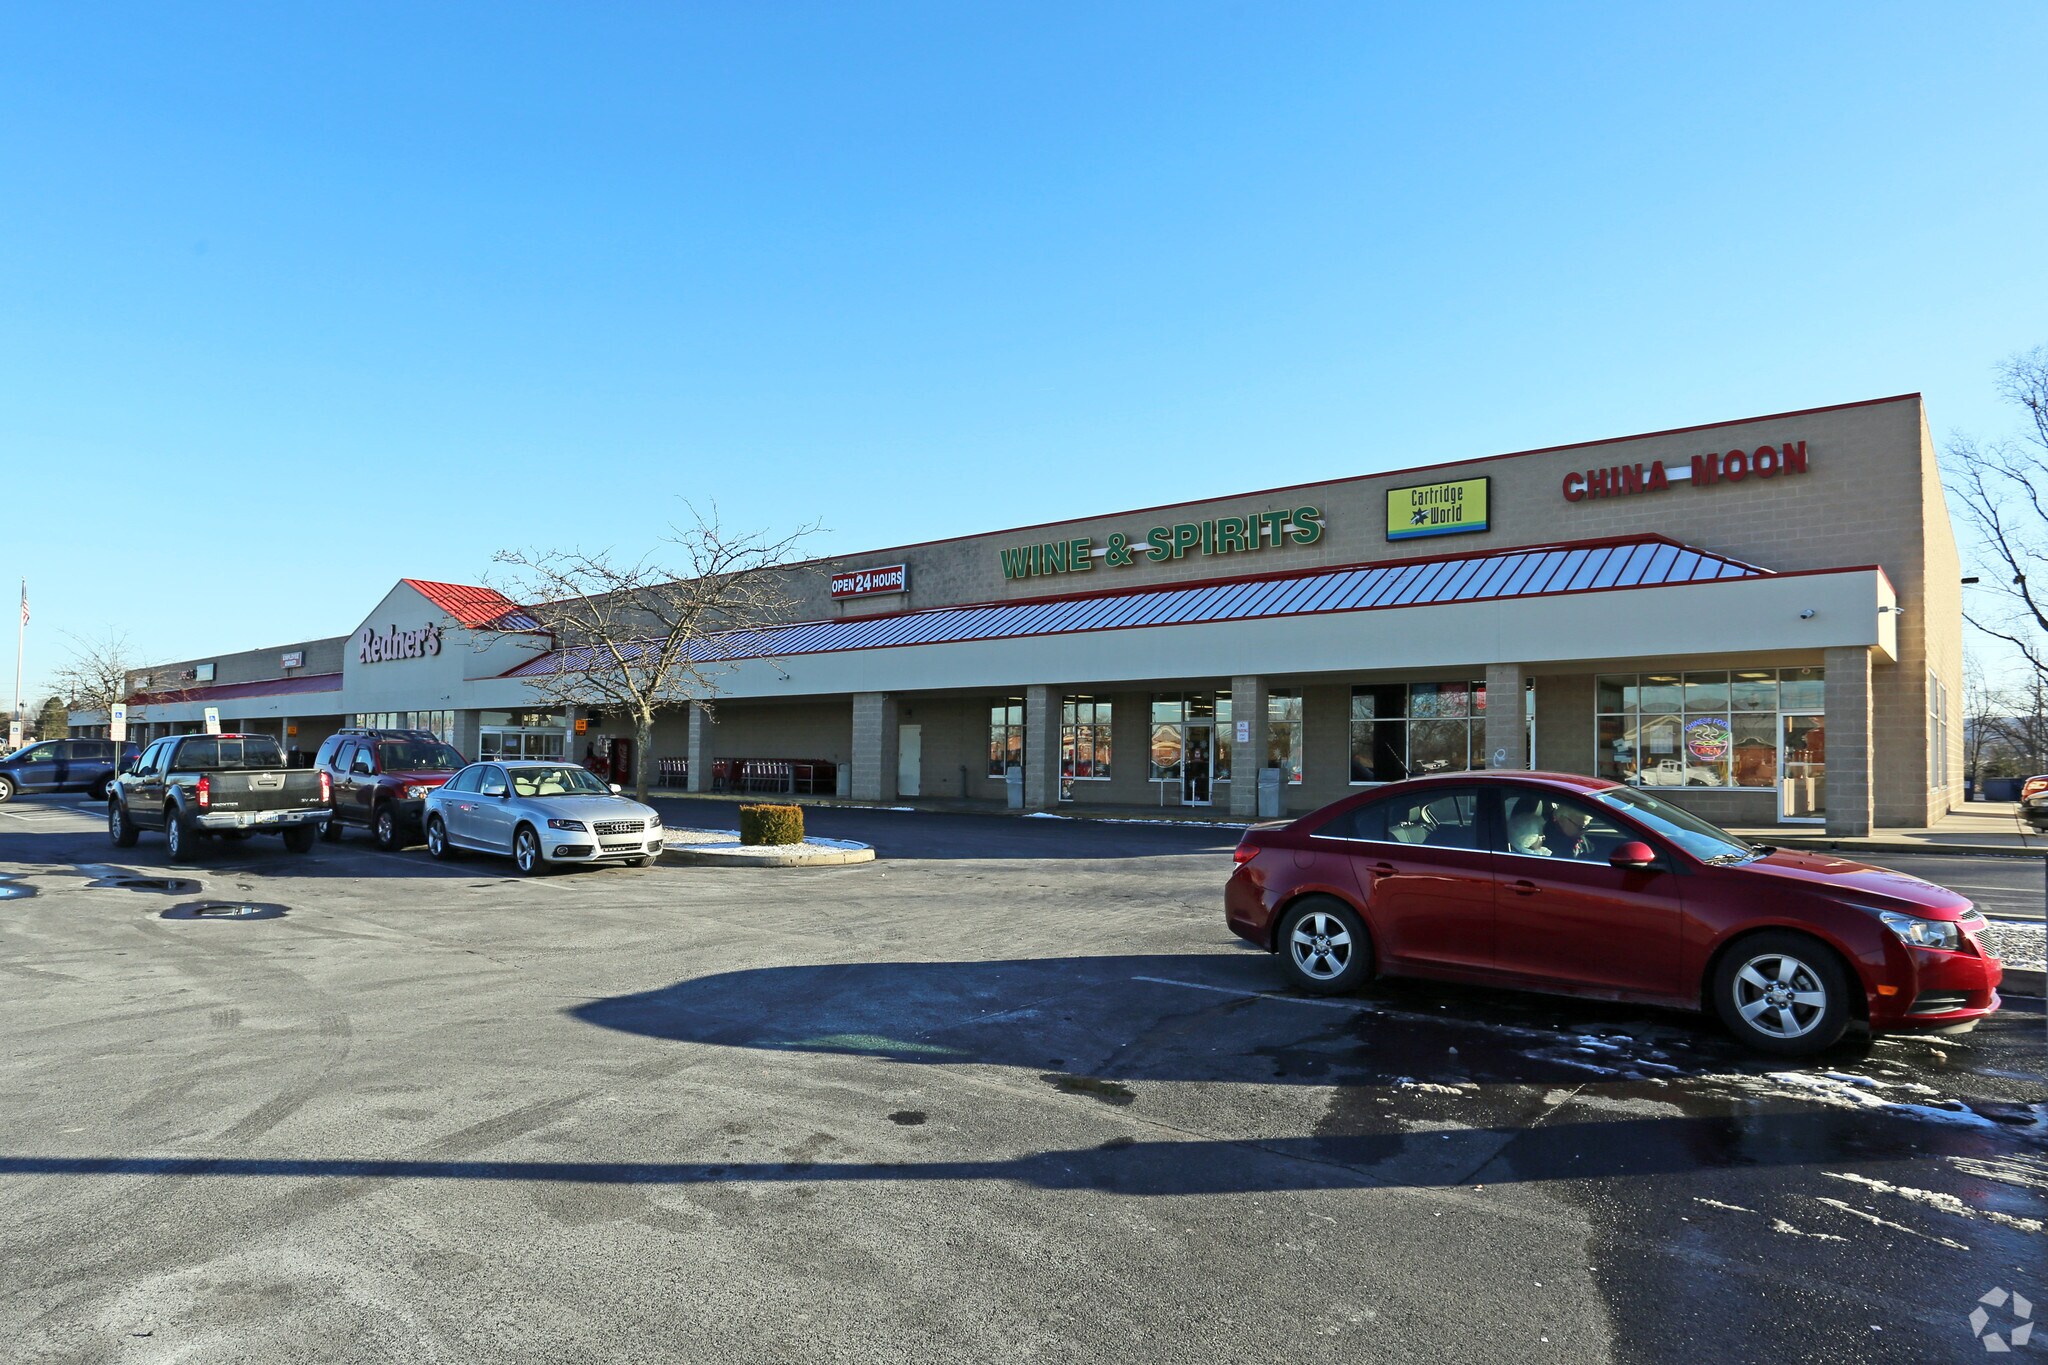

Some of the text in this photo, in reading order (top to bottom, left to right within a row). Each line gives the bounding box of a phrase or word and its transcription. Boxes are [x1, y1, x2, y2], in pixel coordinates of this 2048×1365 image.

[1562, 441, 1808, 502] CHINA MOON
[1411, 485, 1463, 506] Cartridge
[1430, 503, 1462, 525] World
[1000, 505, 1323, 580] WINE & SPIRITS
[832, 571, 902, 592] OPEN 24 HOURS
[359, 622, 441, 664] Redner's
[1685, 717, 1712, 731] CHINESE
[1696, 747, 1721, 755] OPEN
